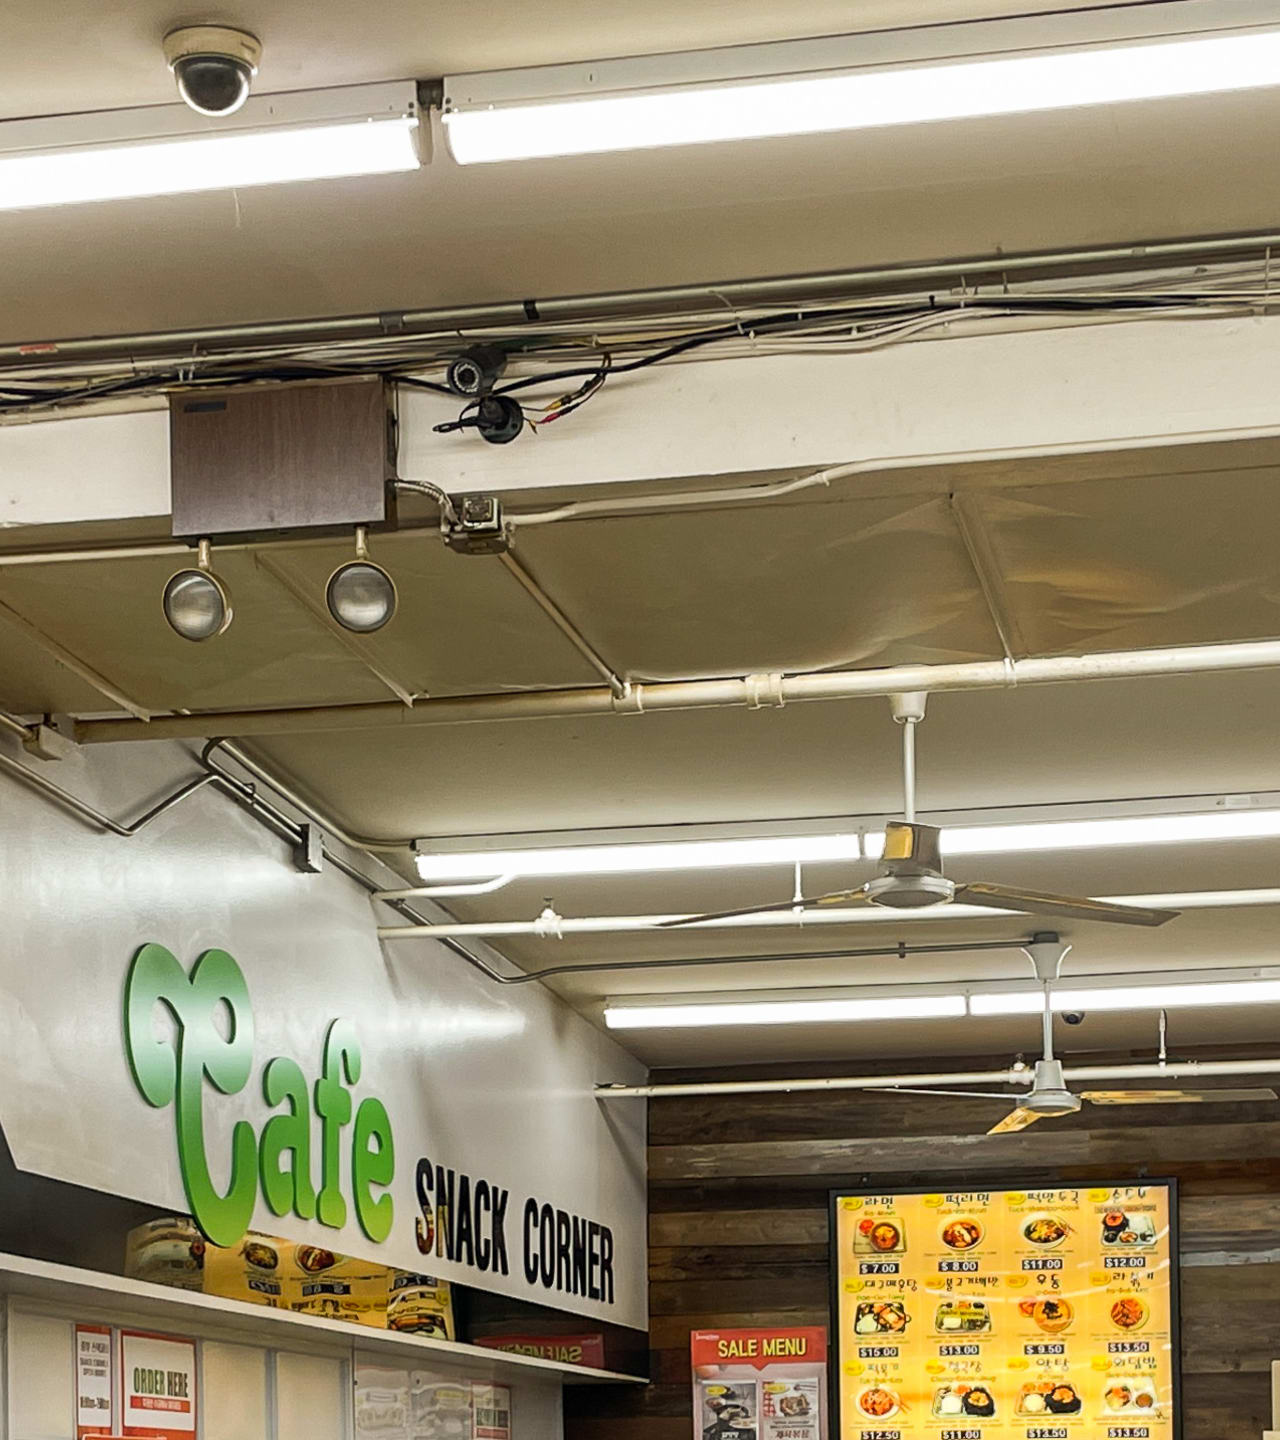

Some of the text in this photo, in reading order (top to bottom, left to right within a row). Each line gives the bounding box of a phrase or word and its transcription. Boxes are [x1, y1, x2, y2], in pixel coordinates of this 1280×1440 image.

[123, 942, 396, 1248] Cafe
[415, 1157, 615, 1305] SNACK CORNER
[1023, 1260, 1061, 1269] $11.00
[1106, 1258, 1144, 1267] $12.00
[718, 1337, 806, 1358] SALE MENU
[941, 1346, 978, 1355] $13.00
[1109, 1343, 1148, 1352] $13.50
[860, 1348, 897, 1357] $15.00
[133, 1367, 188, 1398] ORDER HERE
[862, 1432, 899, 1440] $12.50
[943, 1430, 980, 1439] $11.00
